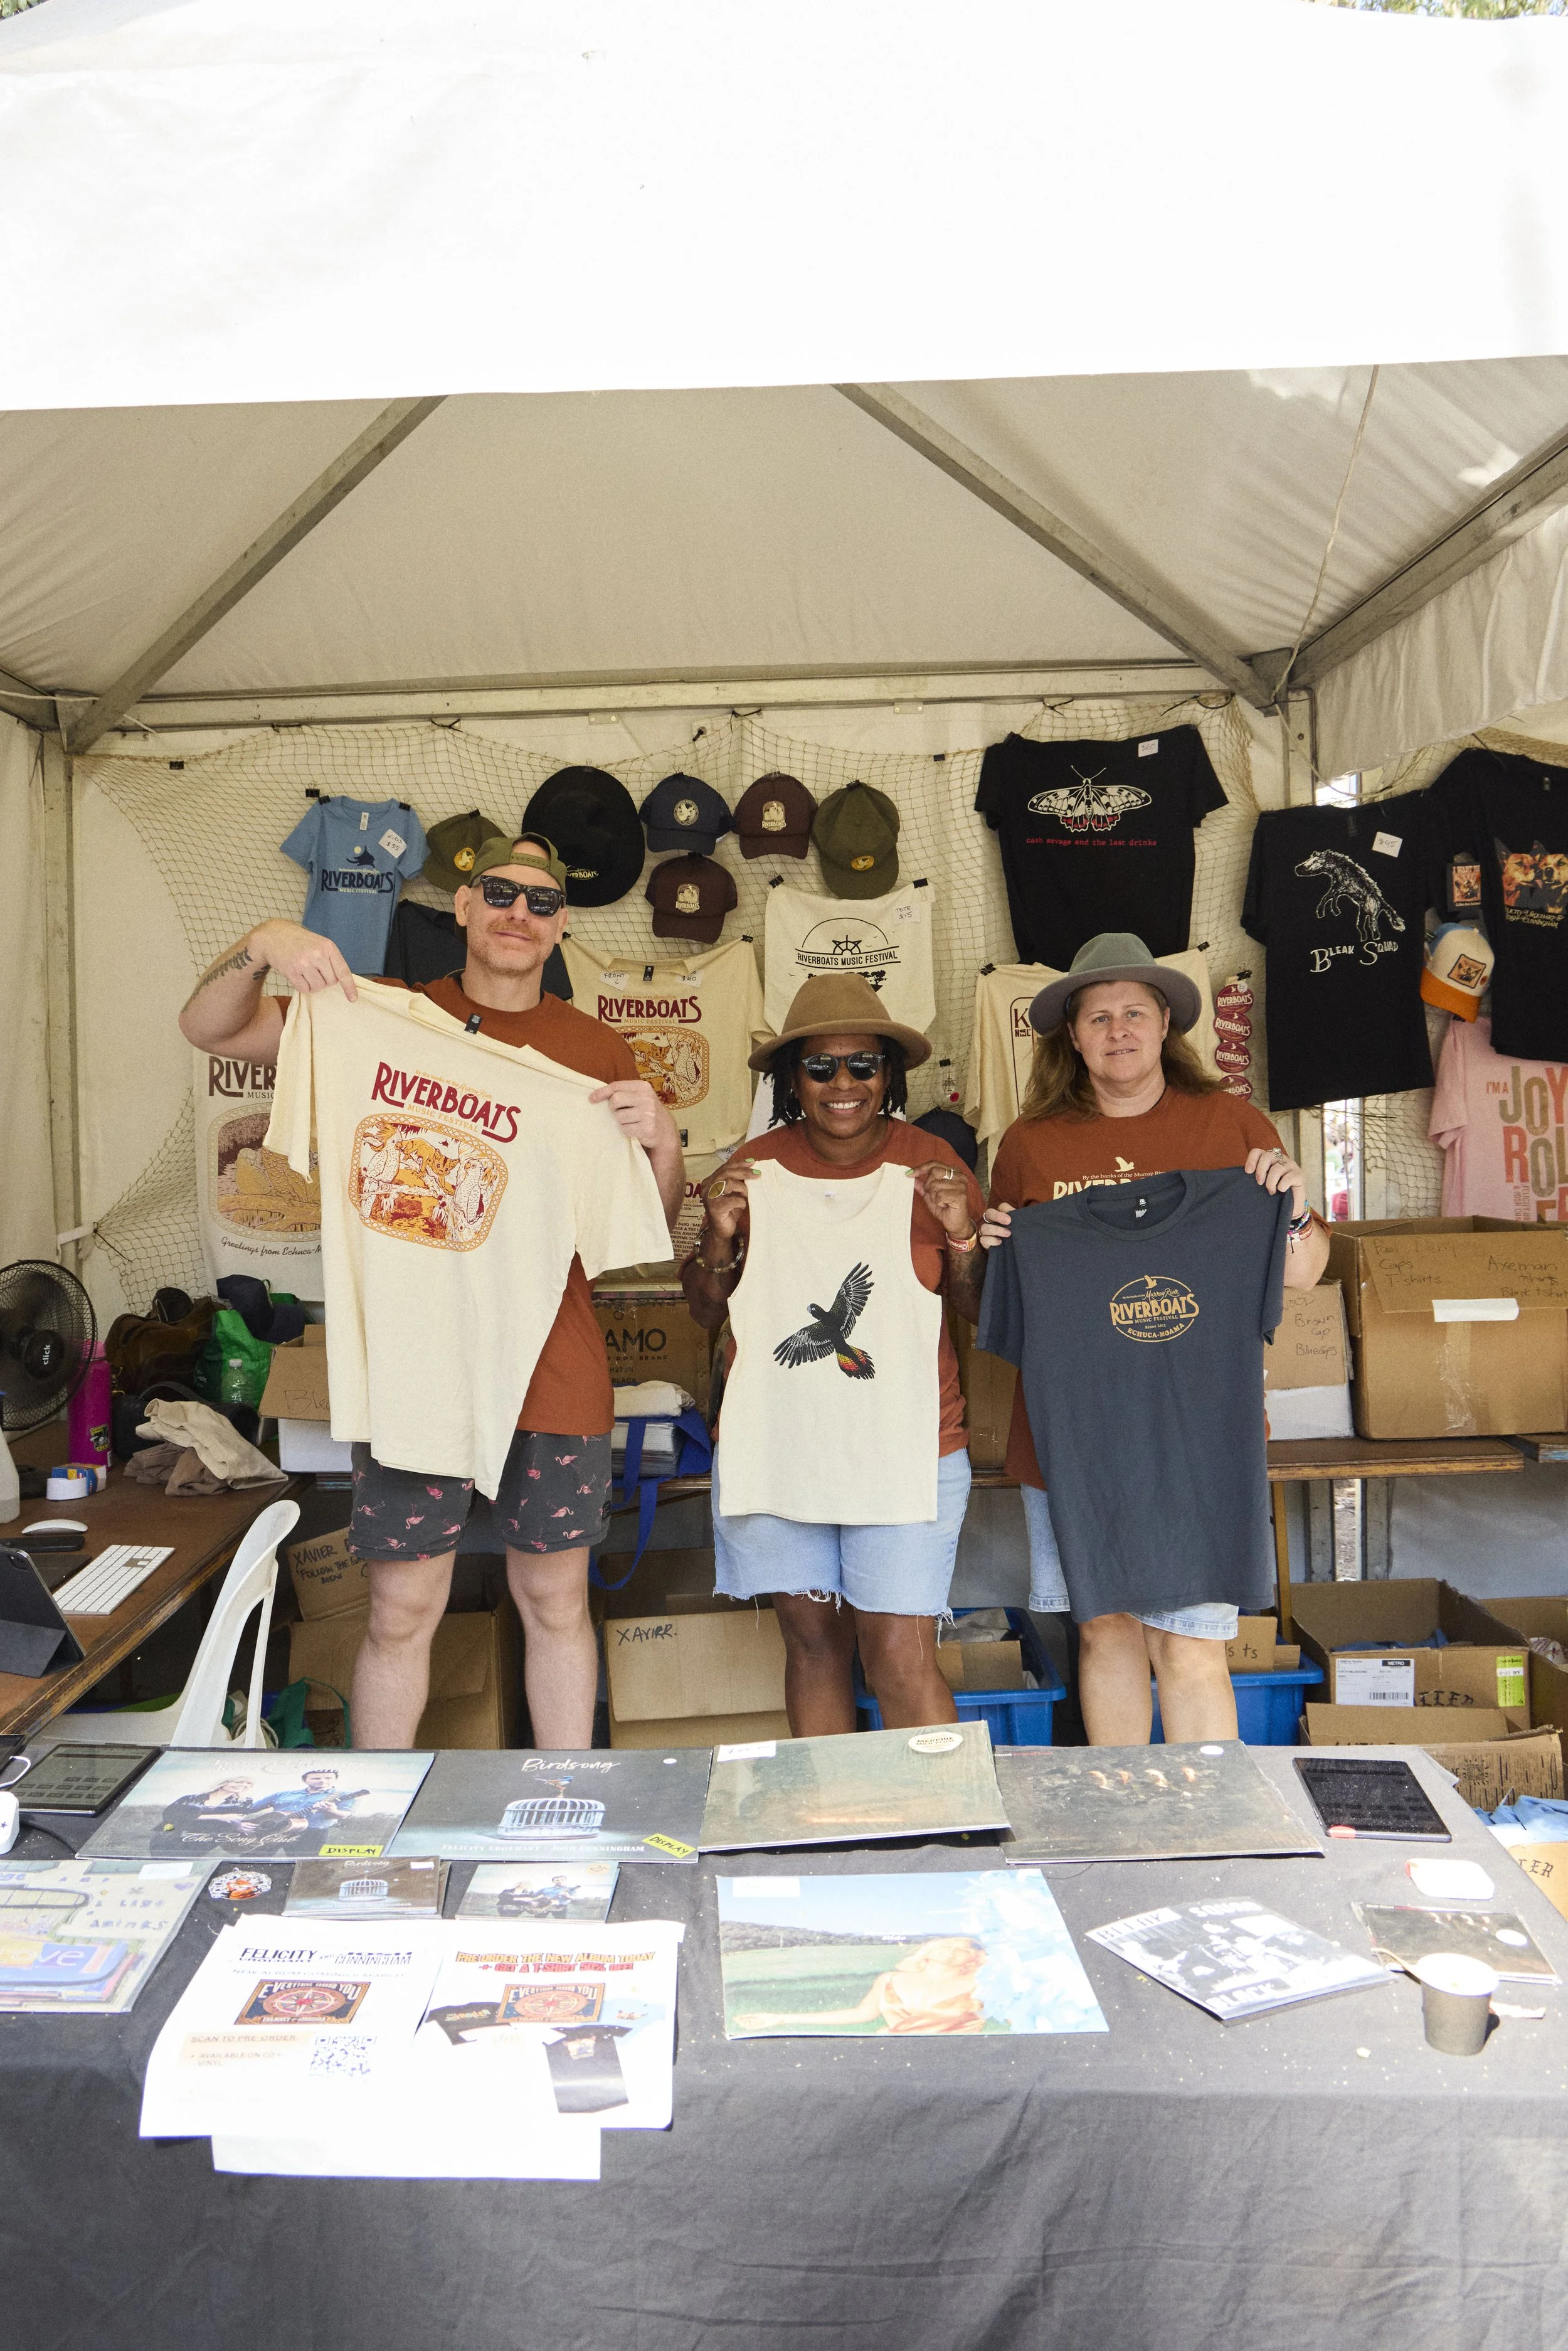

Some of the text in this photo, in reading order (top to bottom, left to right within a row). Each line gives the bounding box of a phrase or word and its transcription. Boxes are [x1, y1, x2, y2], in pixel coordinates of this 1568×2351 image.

[762, 820, 787, 829] RIVERBOATS
[321, 869, 394, 894] RIVERBOATS
[675, 901, 700, 910] RIVERBOATS
[797, 951, 898, 965] RIVERBOATS MUSIC FESTIVAL
[1217, 994, 1253, 1007] RIVERBOATS
[598, 995, 702, 1023] RIVERBOATS
[1215, 1017, 1251, 1036] RIVERBOATS
[1216, 1049, 1249, 1065] RIVERBOATS
[209, 1056, 277, 1098] RIVER
[1486, 1081, 1509, 1093] I'M A
[371, 1061, 522, 1143] RIVERBOATS
[407, 1103, 478, 1133] MUSIC FESTIVAL
[221, 1236, 321, 1256] Greetings from Echuca-M
[1379, 1259, 1414, 1275] Caps
[1142, 1290, 1165, 1302] Murray
[1164, 1288, 1180, 1298] River
[1110, 1293, 1199, 1325] RIVERBOATS
[1295, 1313, 1335, 1327] Brown
[1127, 1322, 1185, 1338] ECHUCA-MOAMA
[605, 1329, 667, 1352] AMO
[294, 1545, 338, 1569] XAVIER
[521, 1758, 621, 1773] Birdsong
[182, 1832, 302, 1847] The Song Club
[649, 1836, 689, 1855] DISPLAY
[241, 1948, 317, 1960] FELICITY
[334, 1955, 412, 1966] CUNNINGHAM
[455, 1951, 656, 1963] PRE-ORDER THE NEW ALBUM TODAY
[493, 1963, 517, 1973] GET
[519, 1963, 530, 1973] A
[533, 1963, 578, 1973] T-SHIRT
[579, 1962, 607, 1972] 50%
[258, 1982, 312, 1998] EVERYTHING
[339, 1983, 363, 2000] YOU
[577, 1985, 599, 2001] YOU
